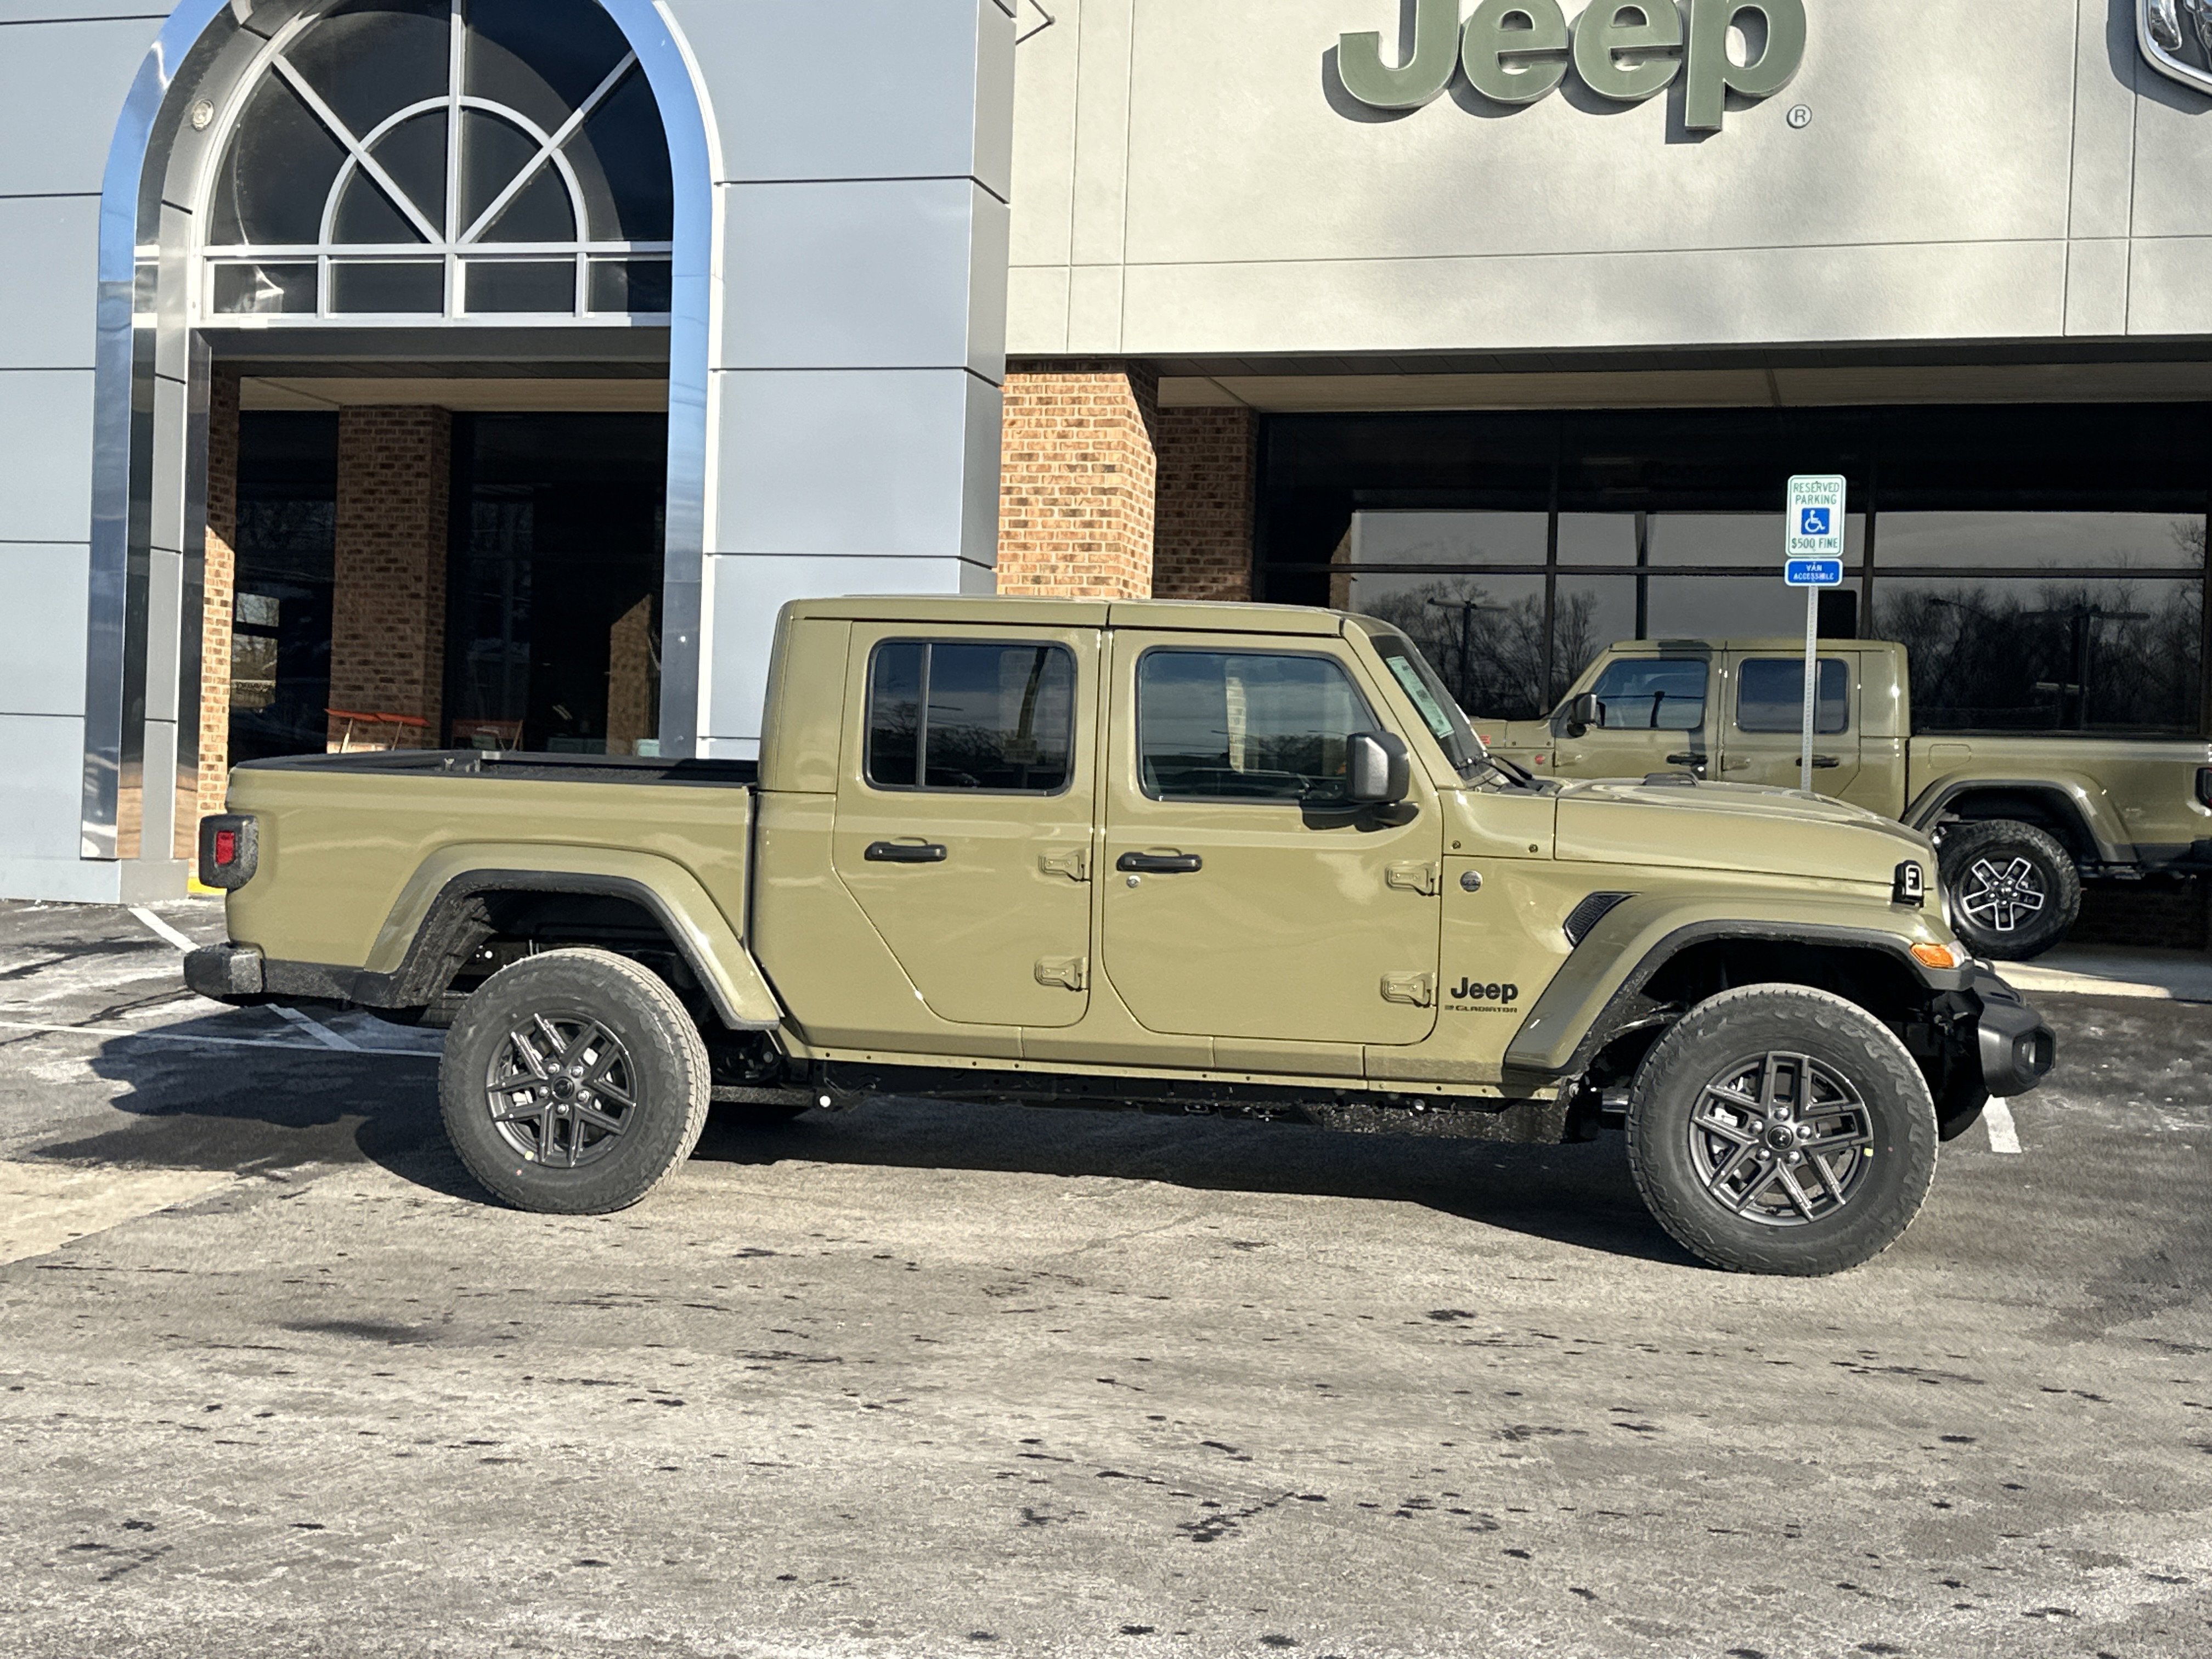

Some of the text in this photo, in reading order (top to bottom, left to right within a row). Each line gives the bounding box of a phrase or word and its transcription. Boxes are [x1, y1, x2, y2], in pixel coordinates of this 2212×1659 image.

[1336, 0, 1807, 131] Jeep
[1793, 482, 1840, 493] RESERVED
[1795, 494, 1837, 505] PARKING
[1791, 538, 1838, 549] $500 FINE
[1451, 977, 1519, 1004] Jeep
